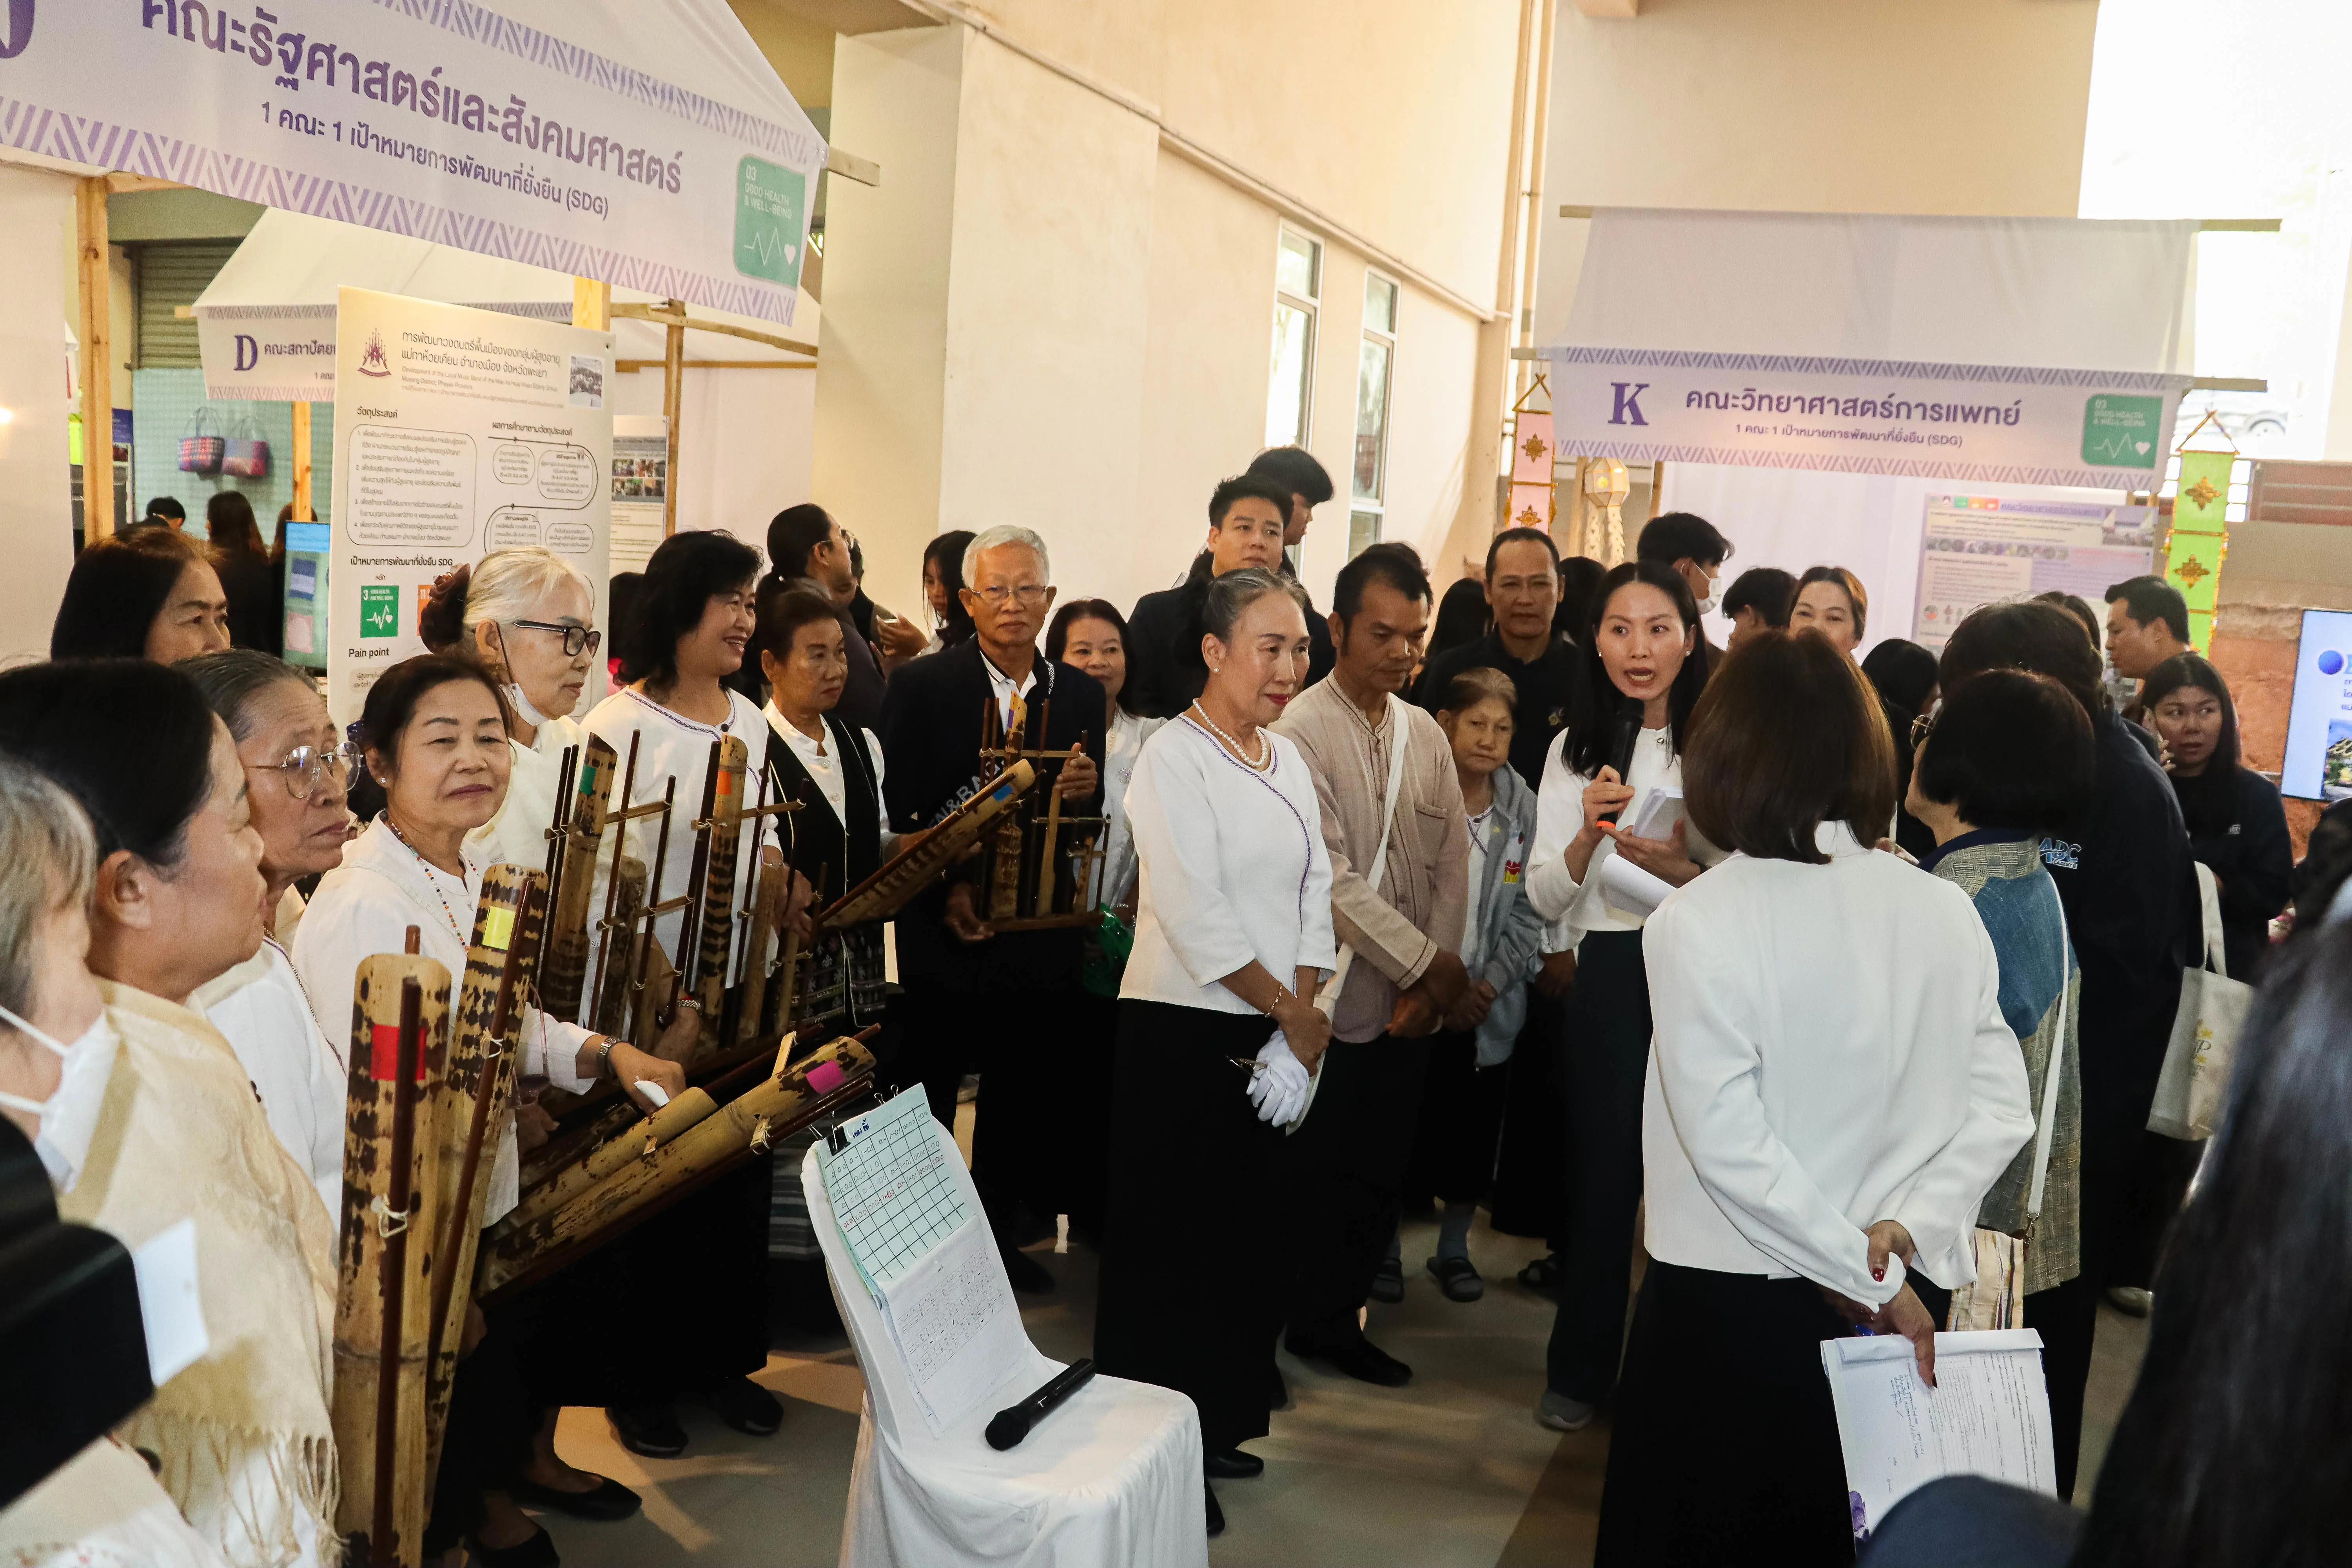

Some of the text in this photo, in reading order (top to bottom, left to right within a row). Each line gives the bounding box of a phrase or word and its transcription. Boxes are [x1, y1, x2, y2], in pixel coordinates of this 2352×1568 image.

[142, 0, 682, 195] คณะรัฐศาสตร์และสังคมศาสตร์
[261, 102, 609, 220] 1 คณะ 1 เป้าหมายการพัฒนาที่ยั่งยืน (SDG)
[745, 164, 757, 181] 03
[745, 182, 789, 206] GOOD HEALTH
[234, 334, 259, 372] D
[1608, 381, 1651, 426] K
[1686, 387, 2022, 426] คณะวิทยาศาสตร์การแพทย์
[1736, 423, 1963, 448] 1 คณะ 1 เป้าหมายการพัฒนาที่ยั่งยืน (SDG)
[350, 554, 436, 566] เป้าหมายการพัฒนาที่ยั่งยืน
[363, 589, 369, 601] 3
[348, 648, 389, 659] Pain point
